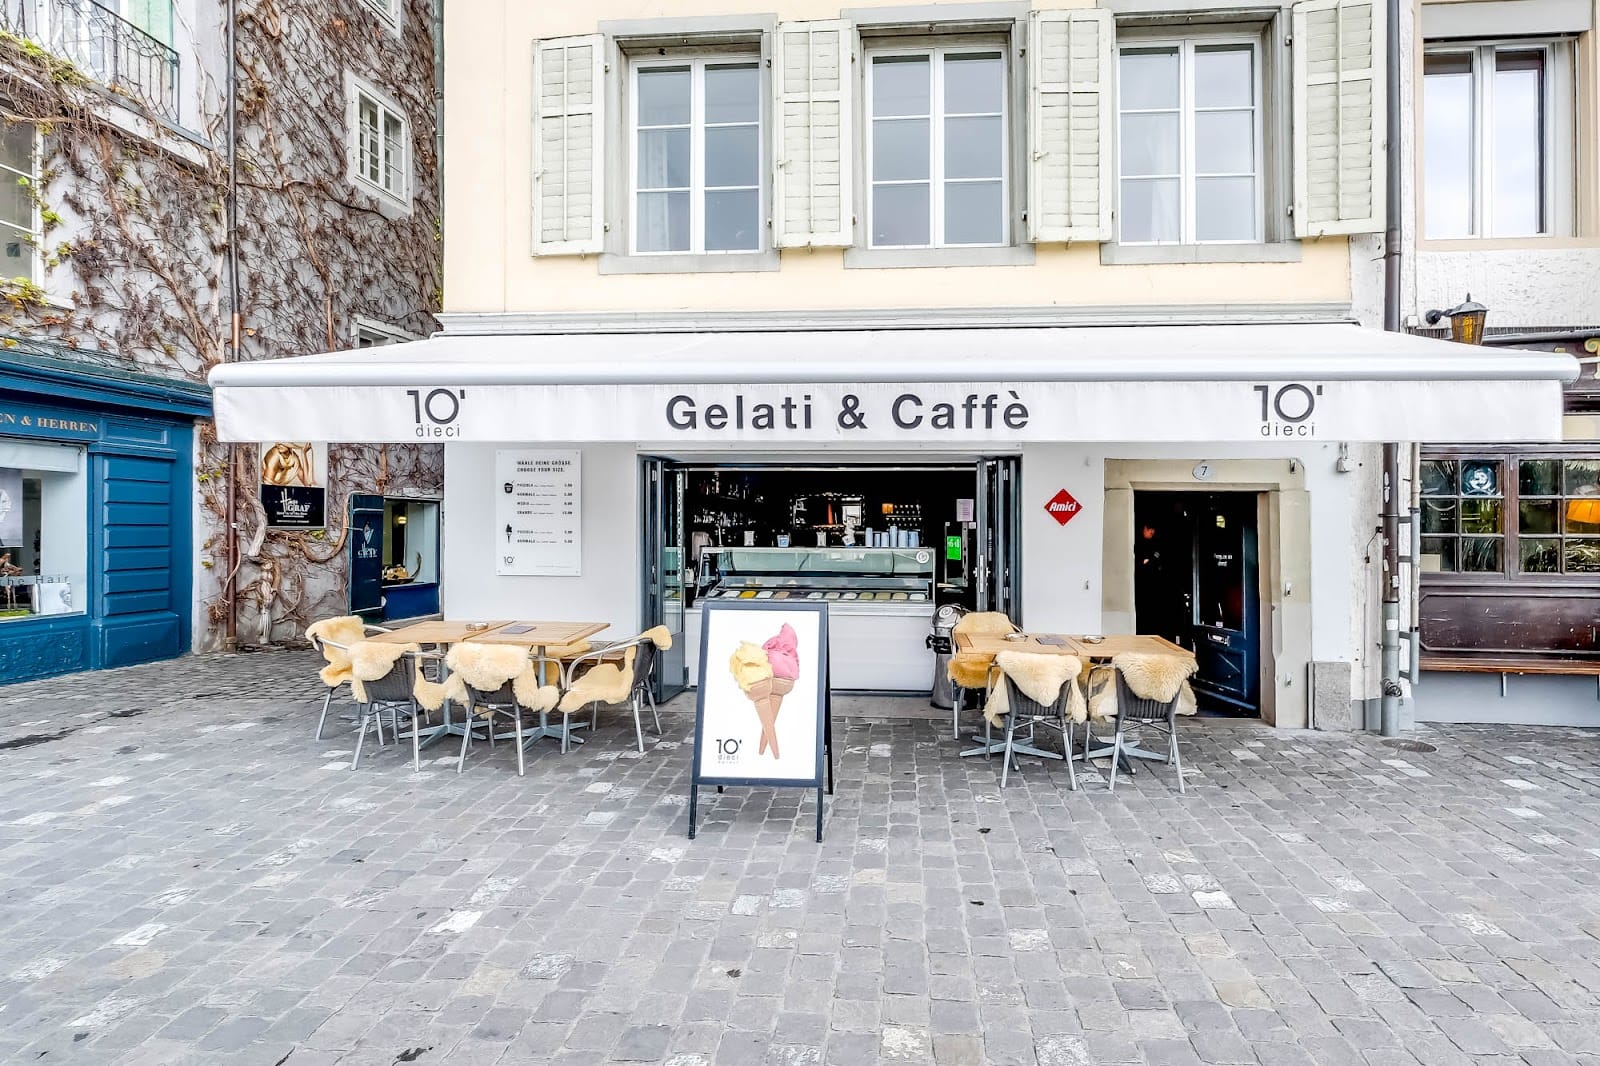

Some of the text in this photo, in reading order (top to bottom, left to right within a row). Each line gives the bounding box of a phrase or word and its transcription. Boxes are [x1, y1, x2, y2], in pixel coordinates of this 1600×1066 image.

[666, 391, 1029, 430] Gelati & Caffè
[20, 415, 32, 426] &
[37, 417, 98, 432] HERREN
[1260, 422, 1315, 436] dieci
[415, 424, 460, 437] dieci
[1201, 465, 1208, 476] 7
[1049, 501, 1076, 511] Amici
[36, 575, 69, 584] Hair
